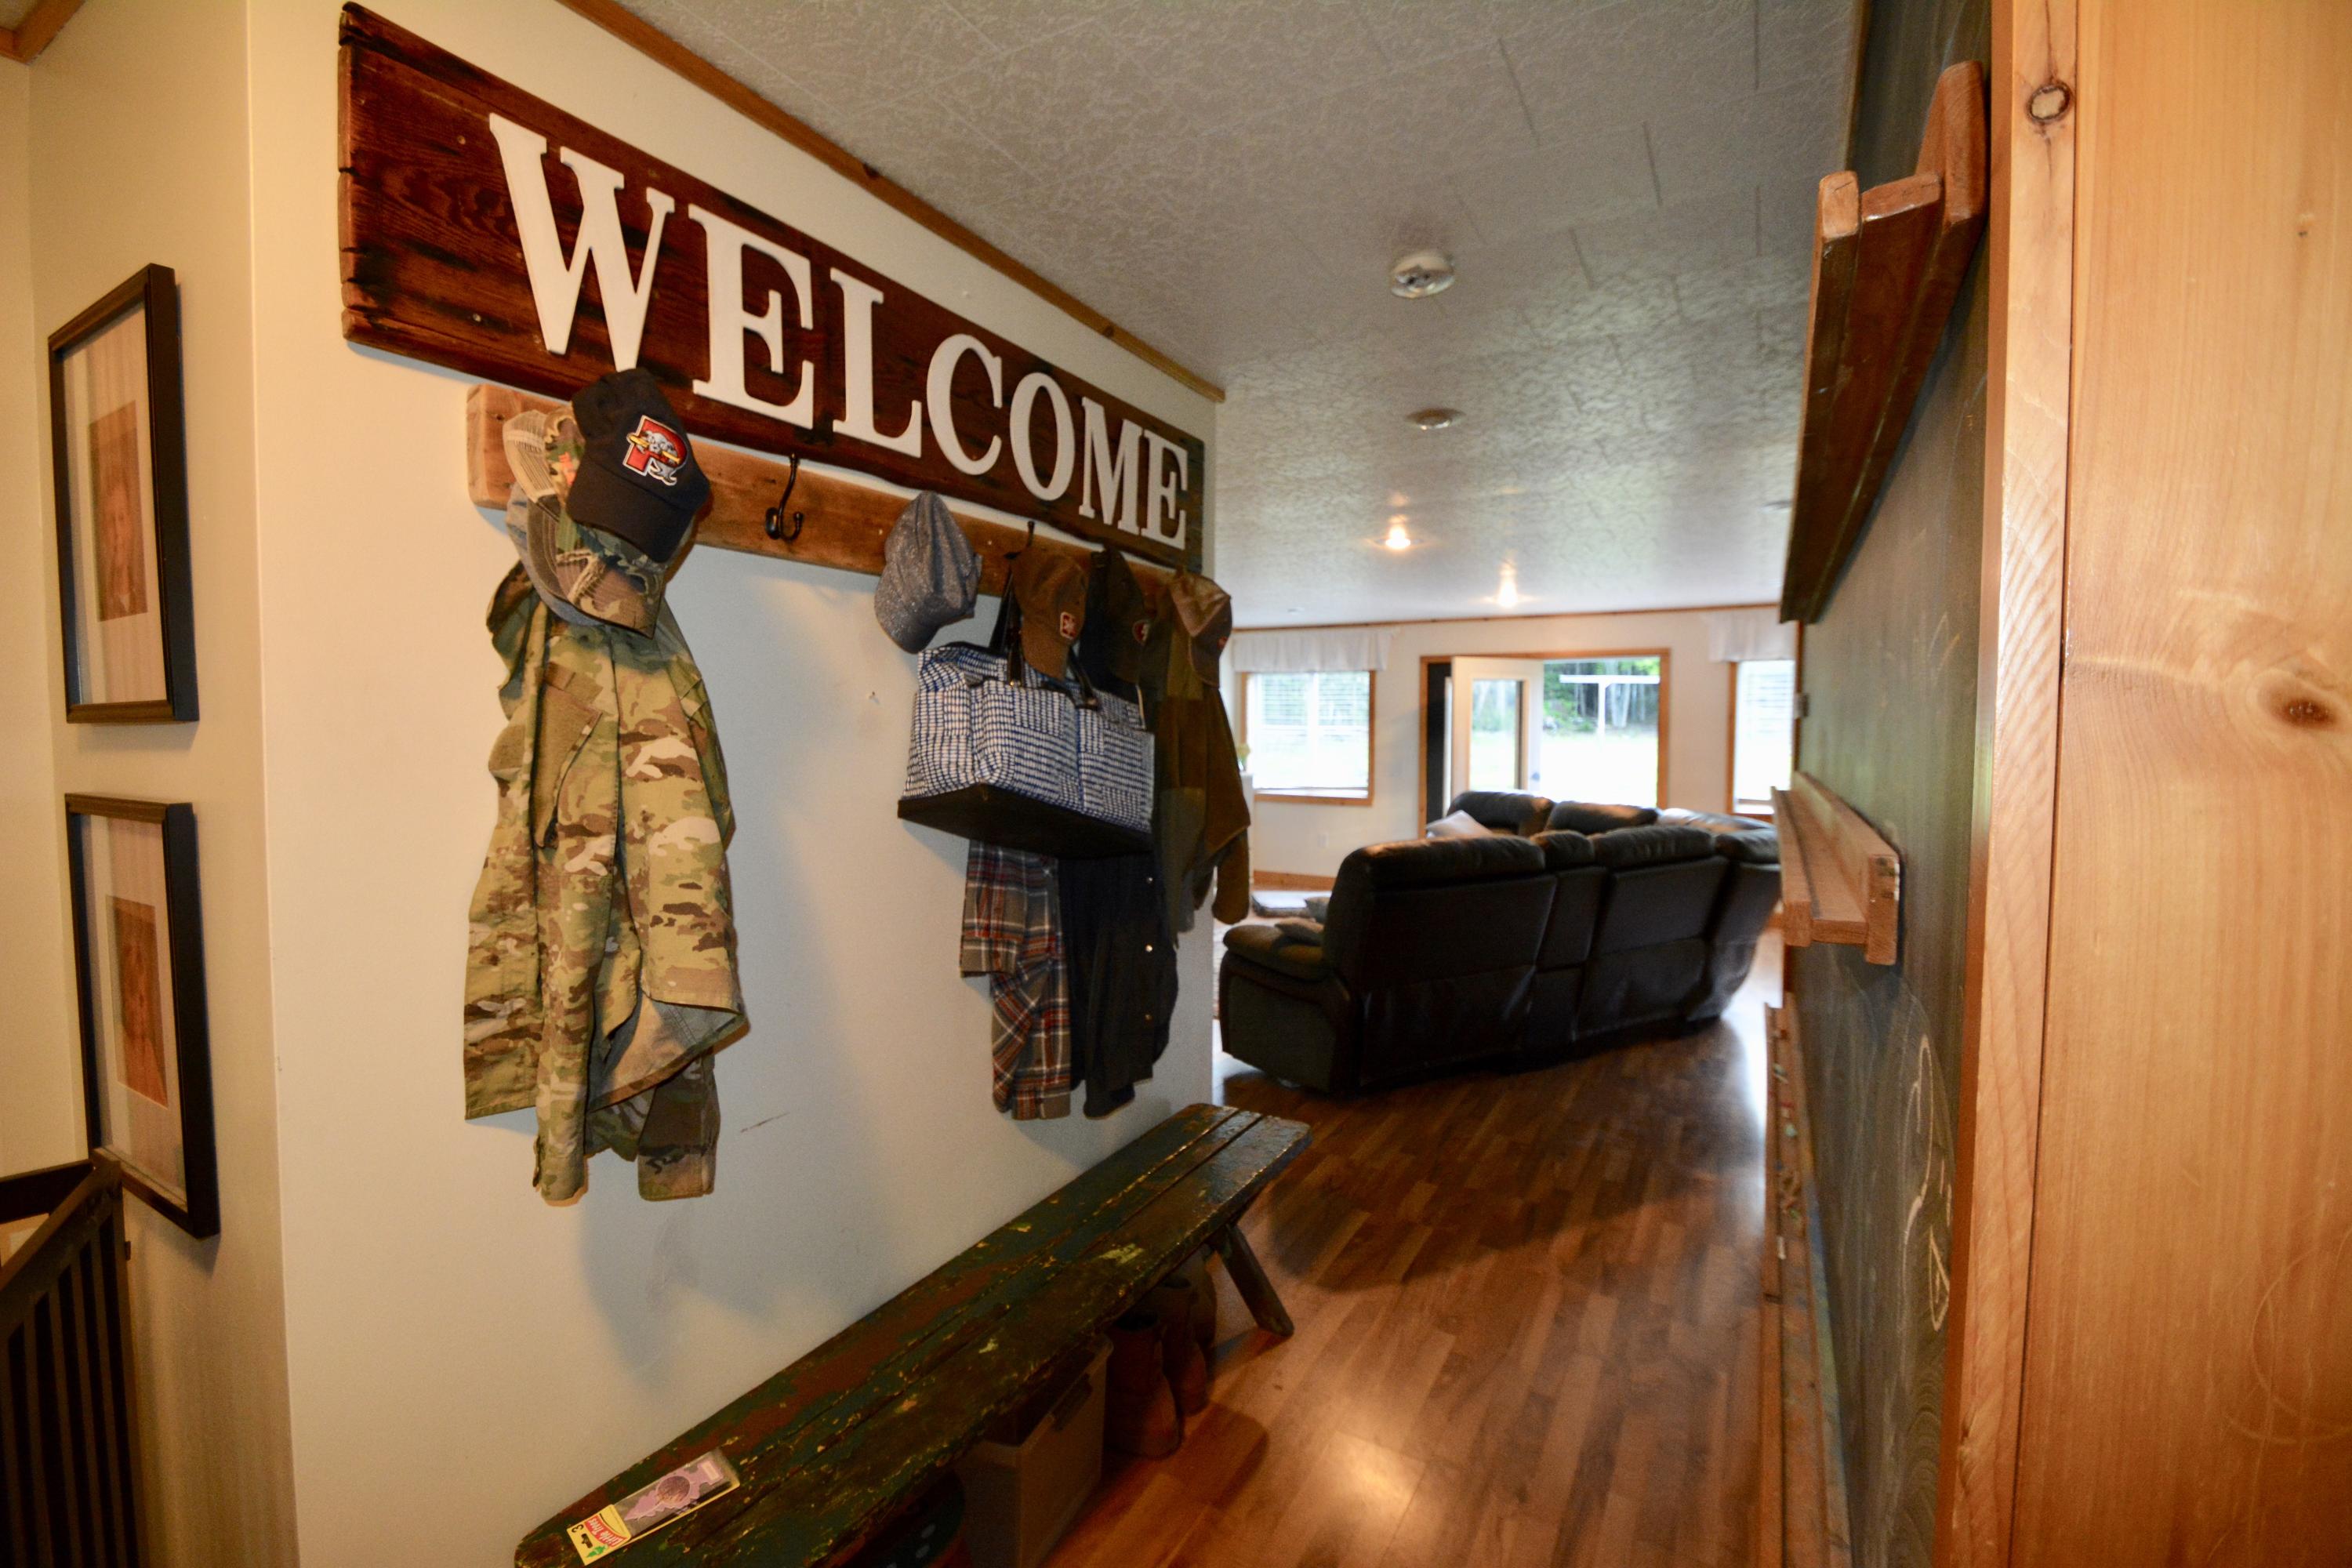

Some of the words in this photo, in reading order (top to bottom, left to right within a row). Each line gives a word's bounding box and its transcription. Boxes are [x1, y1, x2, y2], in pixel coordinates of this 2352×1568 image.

[488, 112, 1188, 550] WELCOME
[572, 1524, 583, 1533] 3
[587, 1518, 604, 1536] Trees
[598, 1530, 623, 1547] Little
